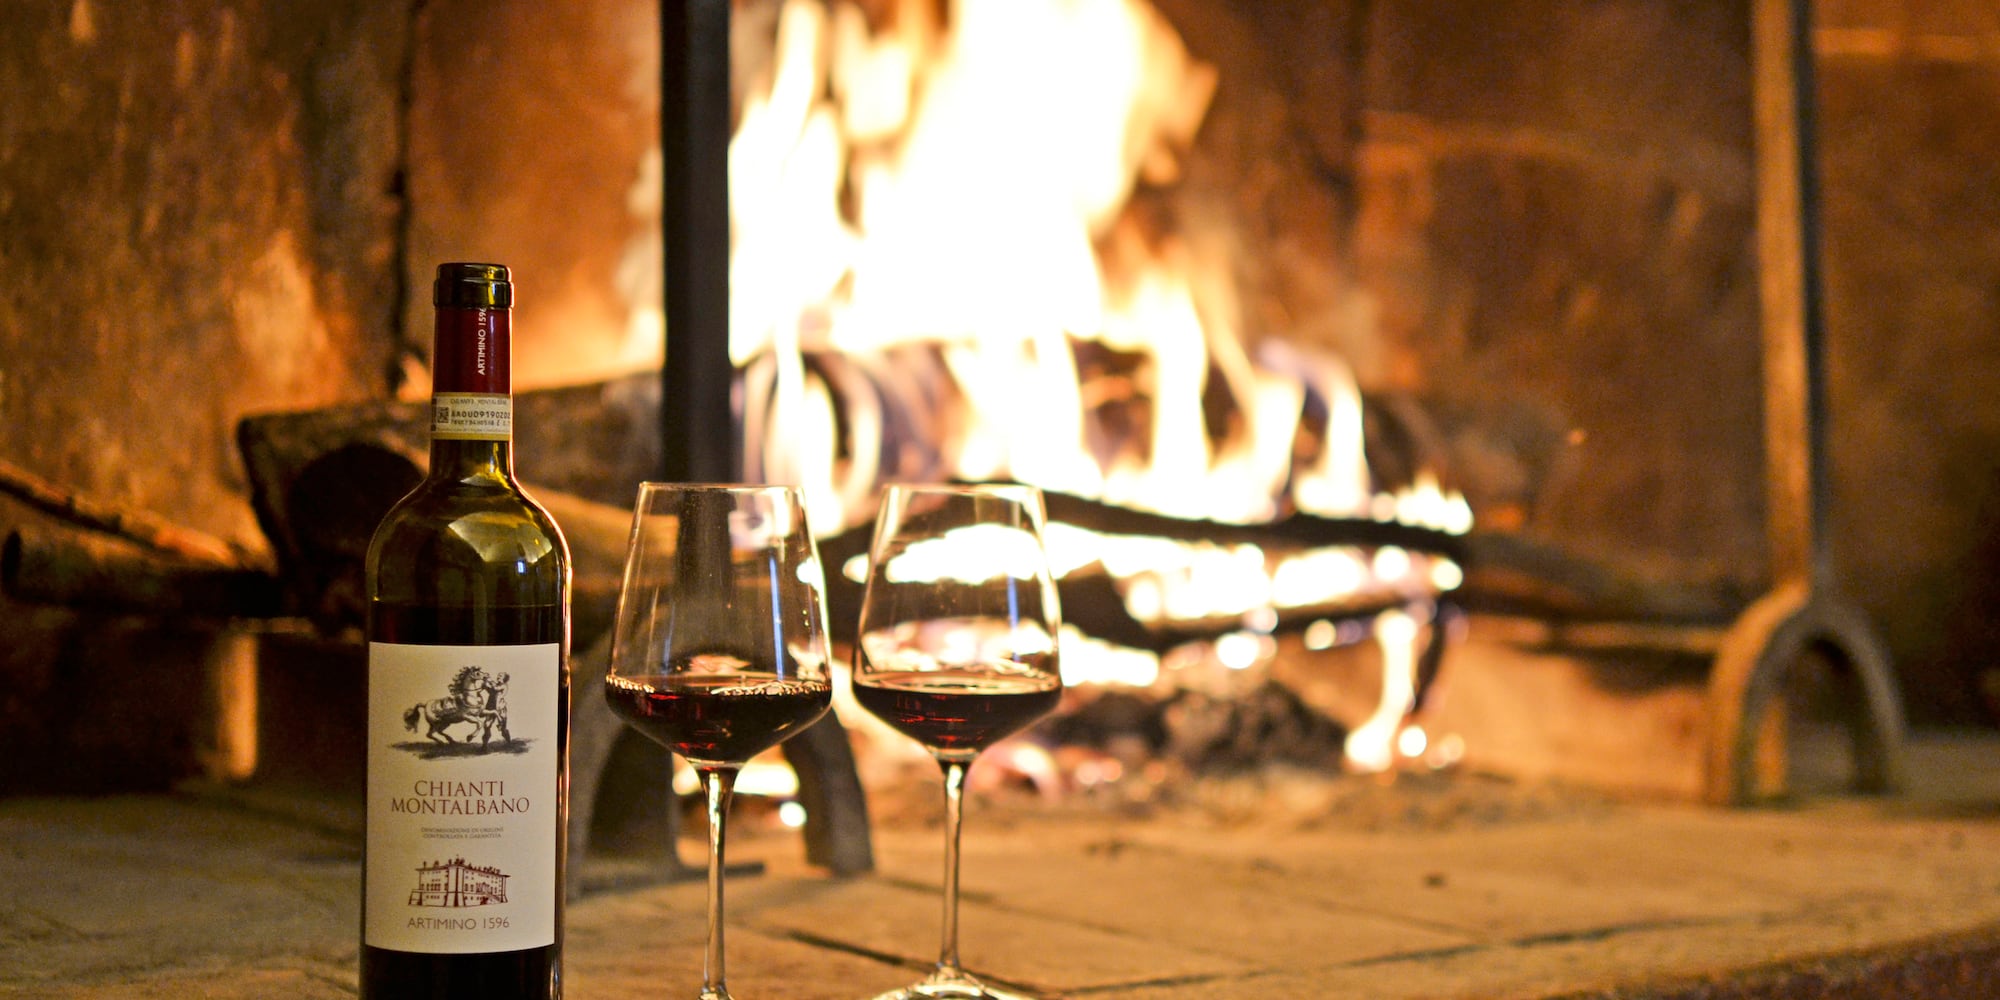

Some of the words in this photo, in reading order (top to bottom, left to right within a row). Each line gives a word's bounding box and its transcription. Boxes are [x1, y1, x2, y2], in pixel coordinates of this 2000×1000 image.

[477, 329, 487, 375] ARTIMINO
[414, 779, 505, 797] CHIANTI
[391, 797, 530, 815] MONTALBANO
[407, 917, 477, 930] ARTIMINO
[483, 917, 510, 929] 1596
